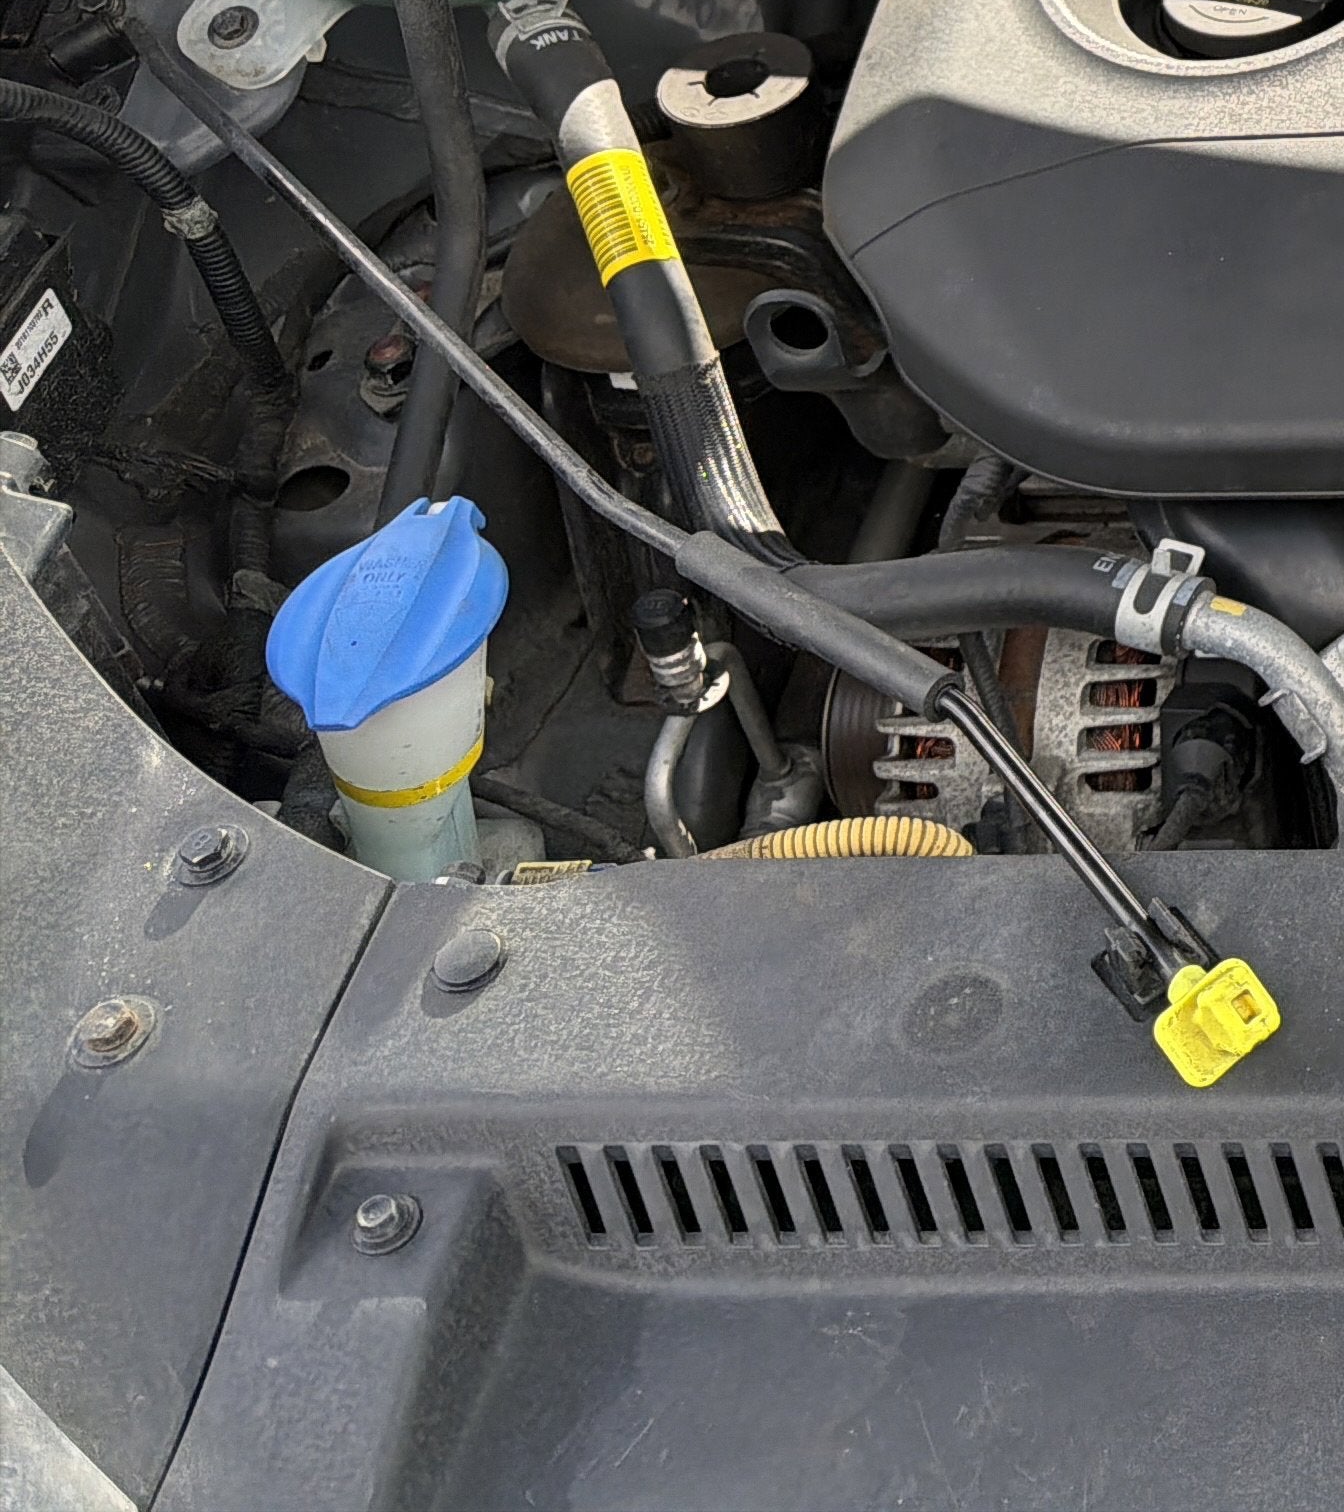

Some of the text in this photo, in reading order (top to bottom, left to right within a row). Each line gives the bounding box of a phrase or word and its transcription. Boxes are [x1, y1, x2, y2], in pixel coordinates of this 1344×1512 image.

[1213, 4, 1248, 16] OPEN
[529, 29, 582, 50] TANK
[363, 571, 407, 584] ONLY
